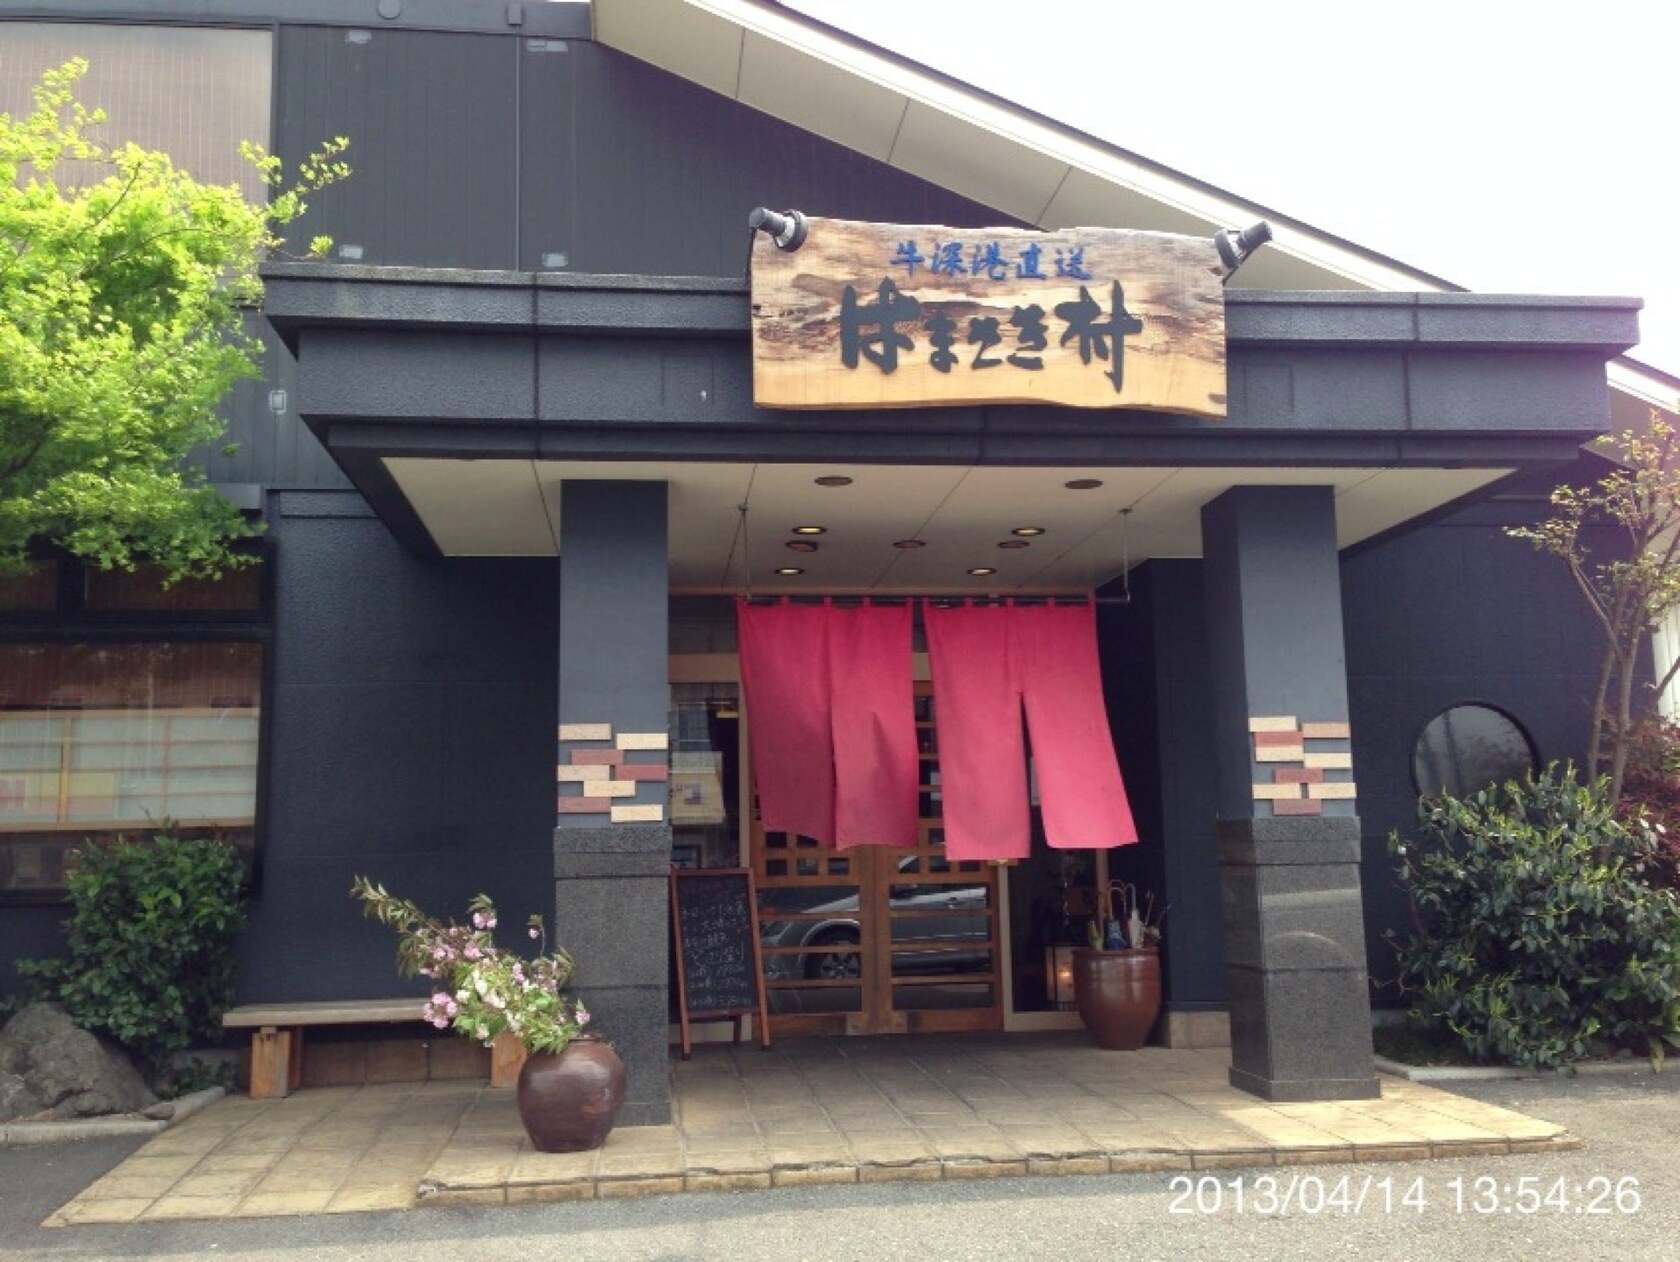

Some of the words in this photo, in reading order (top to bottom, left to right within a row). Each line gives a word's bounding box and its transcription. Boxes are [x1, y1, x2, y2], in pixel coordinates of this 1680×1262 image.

[889, 239, 1092, 281] 牛深港直送
